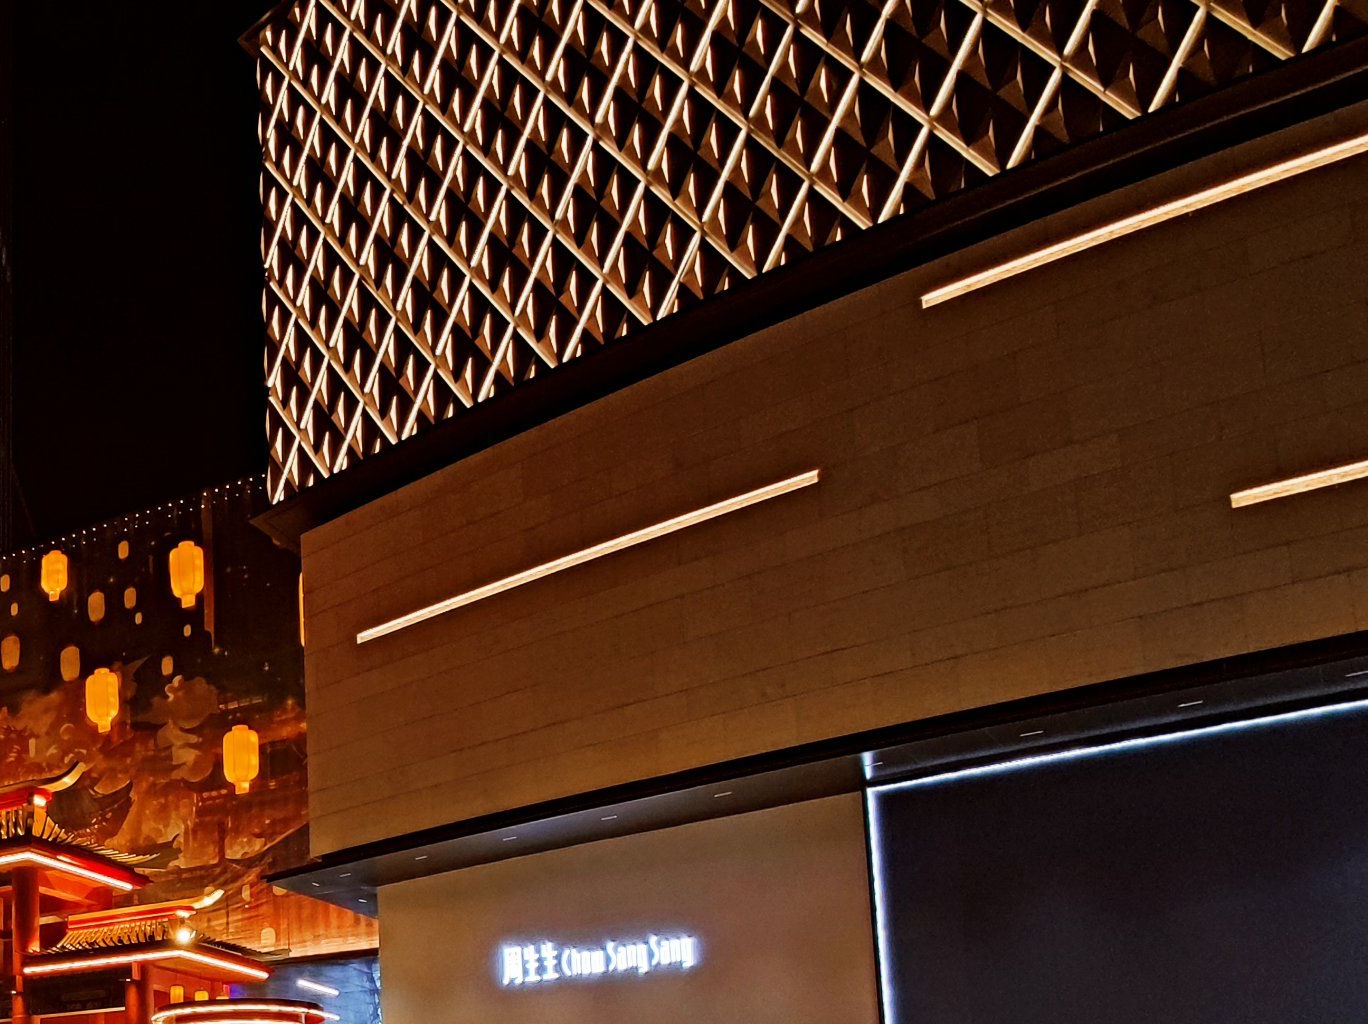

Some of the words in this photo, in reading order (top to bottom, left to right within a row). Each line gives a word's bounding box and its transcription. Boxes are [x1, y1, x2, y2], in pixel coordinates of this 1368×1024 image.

[502, 941, 560, 986] 周生生
[561, 946, 605, 977] Chow
[606, 939, 649, 975] Sang
[649, 934, 696, 969] Sang
